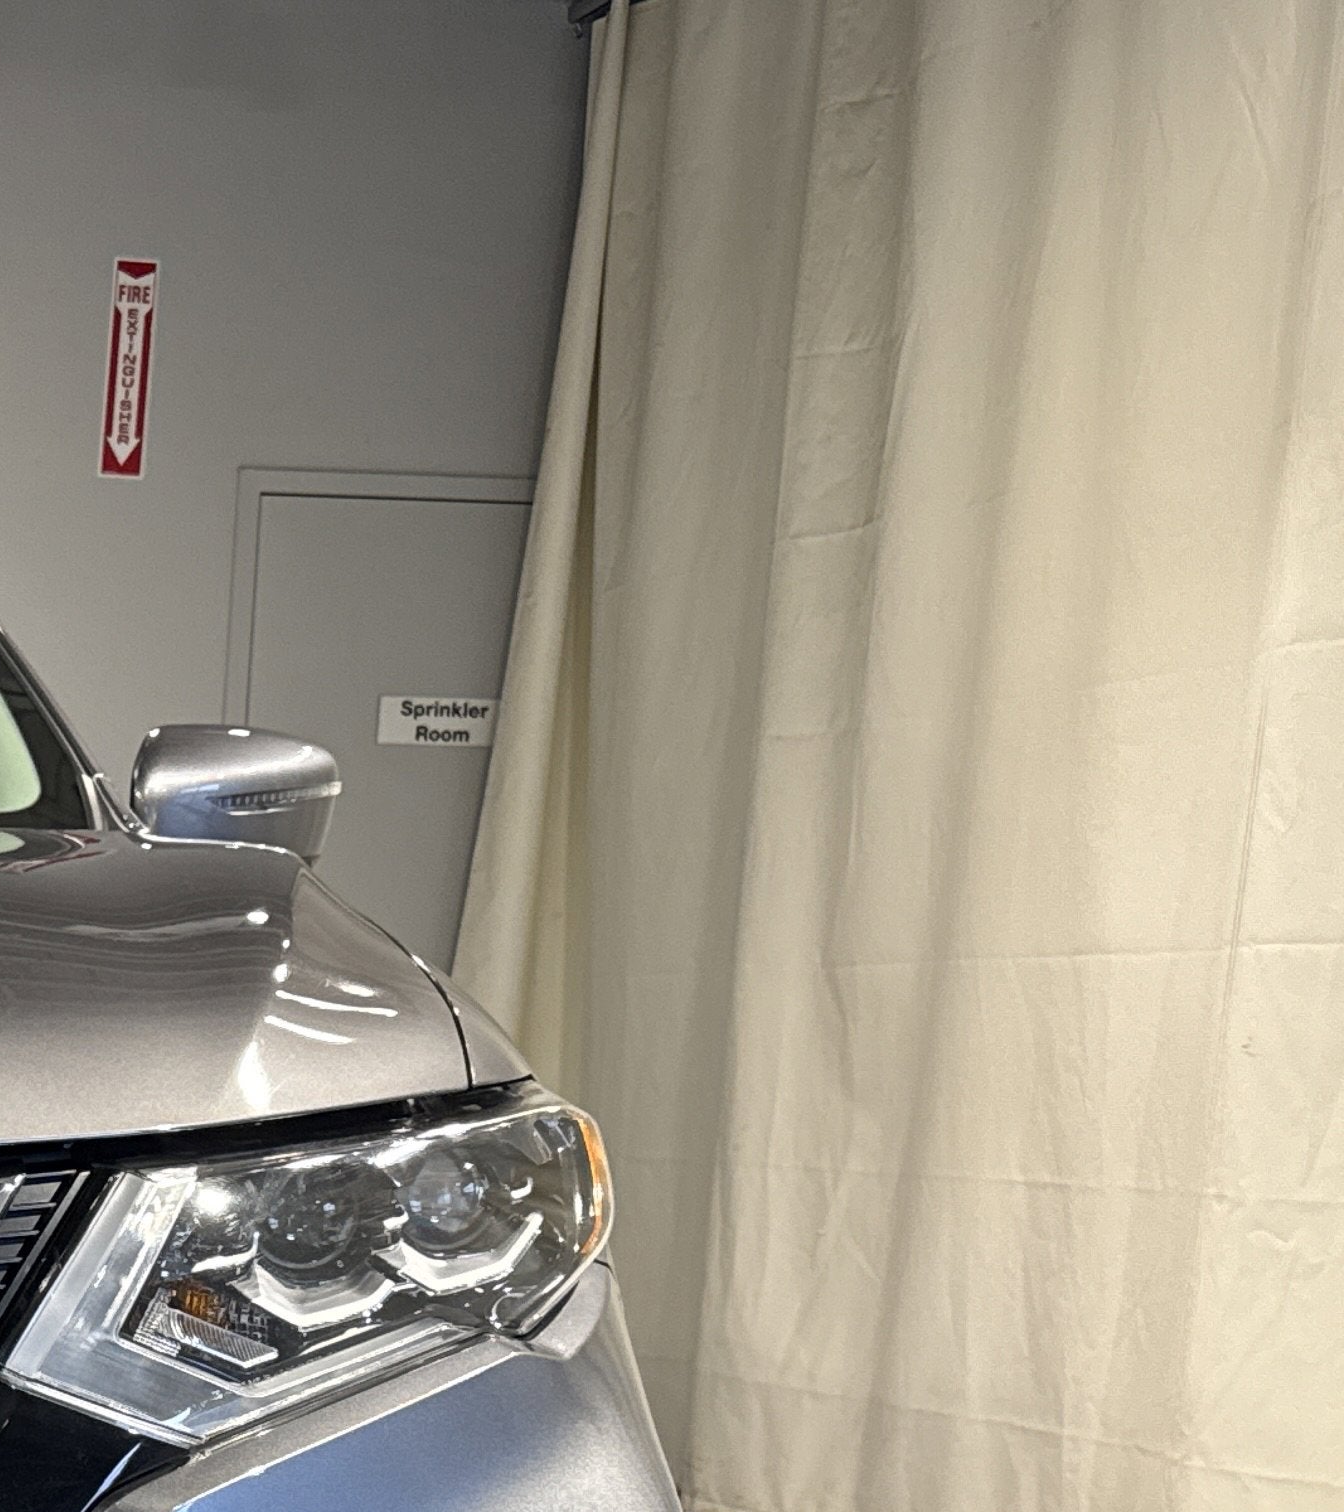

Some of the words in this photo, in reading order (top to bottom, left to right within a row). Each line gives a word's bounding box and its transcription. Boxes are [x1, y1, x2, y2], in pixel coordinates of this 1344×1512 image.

[118, 285, 151, 304] FIRE
[116, 308, 140, 446] EXTINGUISHER
[400, 700, 489, 719] Sprinkler
[415, 725, 470, 742] Room
